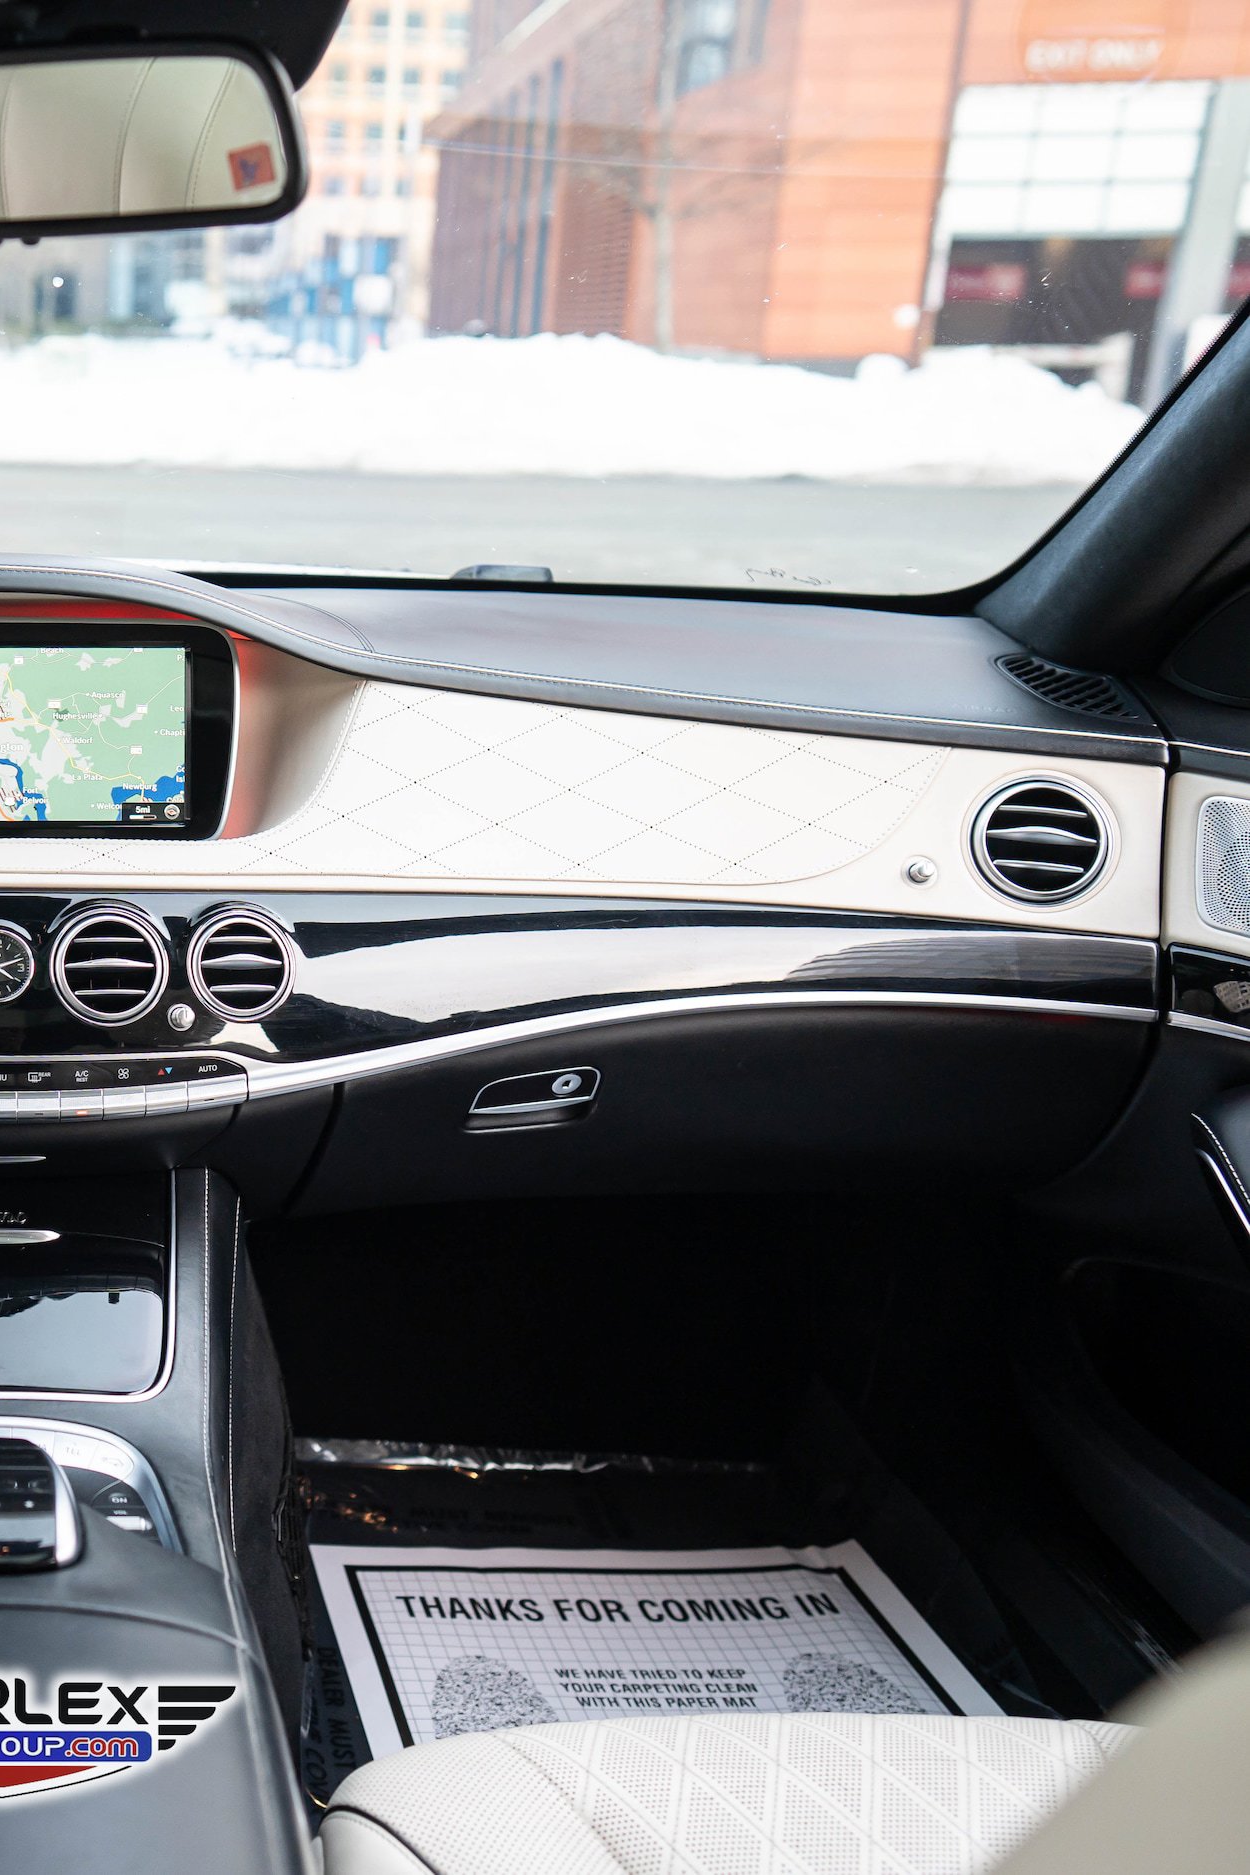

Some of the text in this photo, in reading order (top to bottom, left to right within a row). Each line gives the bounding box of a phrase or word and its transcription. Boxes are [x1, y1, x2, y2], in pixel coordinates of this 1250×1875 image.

[52, 712, 97, 721] Hughesville
[122, 783, 157, 792] Newburg
[135, 805, 150, 814] 5mi
[17, 963, 25, 972] 3
[198, 1063, 218, 1073] AUTO
[74, 1069, 89, 1078] A/C
[395, 1592, 841, 1623] THANKS FOR COMING IN
[316, 1647, 345, 1707] DEALER
[554, 1668, 747, 1680] WE HAVE TRIED TO KEEP
[559, 1682, 759, 1694] YOUR CARPETING CLEAN
[575, 1697, 758, 1708] WITH THIS PAPER MAT
[327, 1717, 357, 1770] MUST
